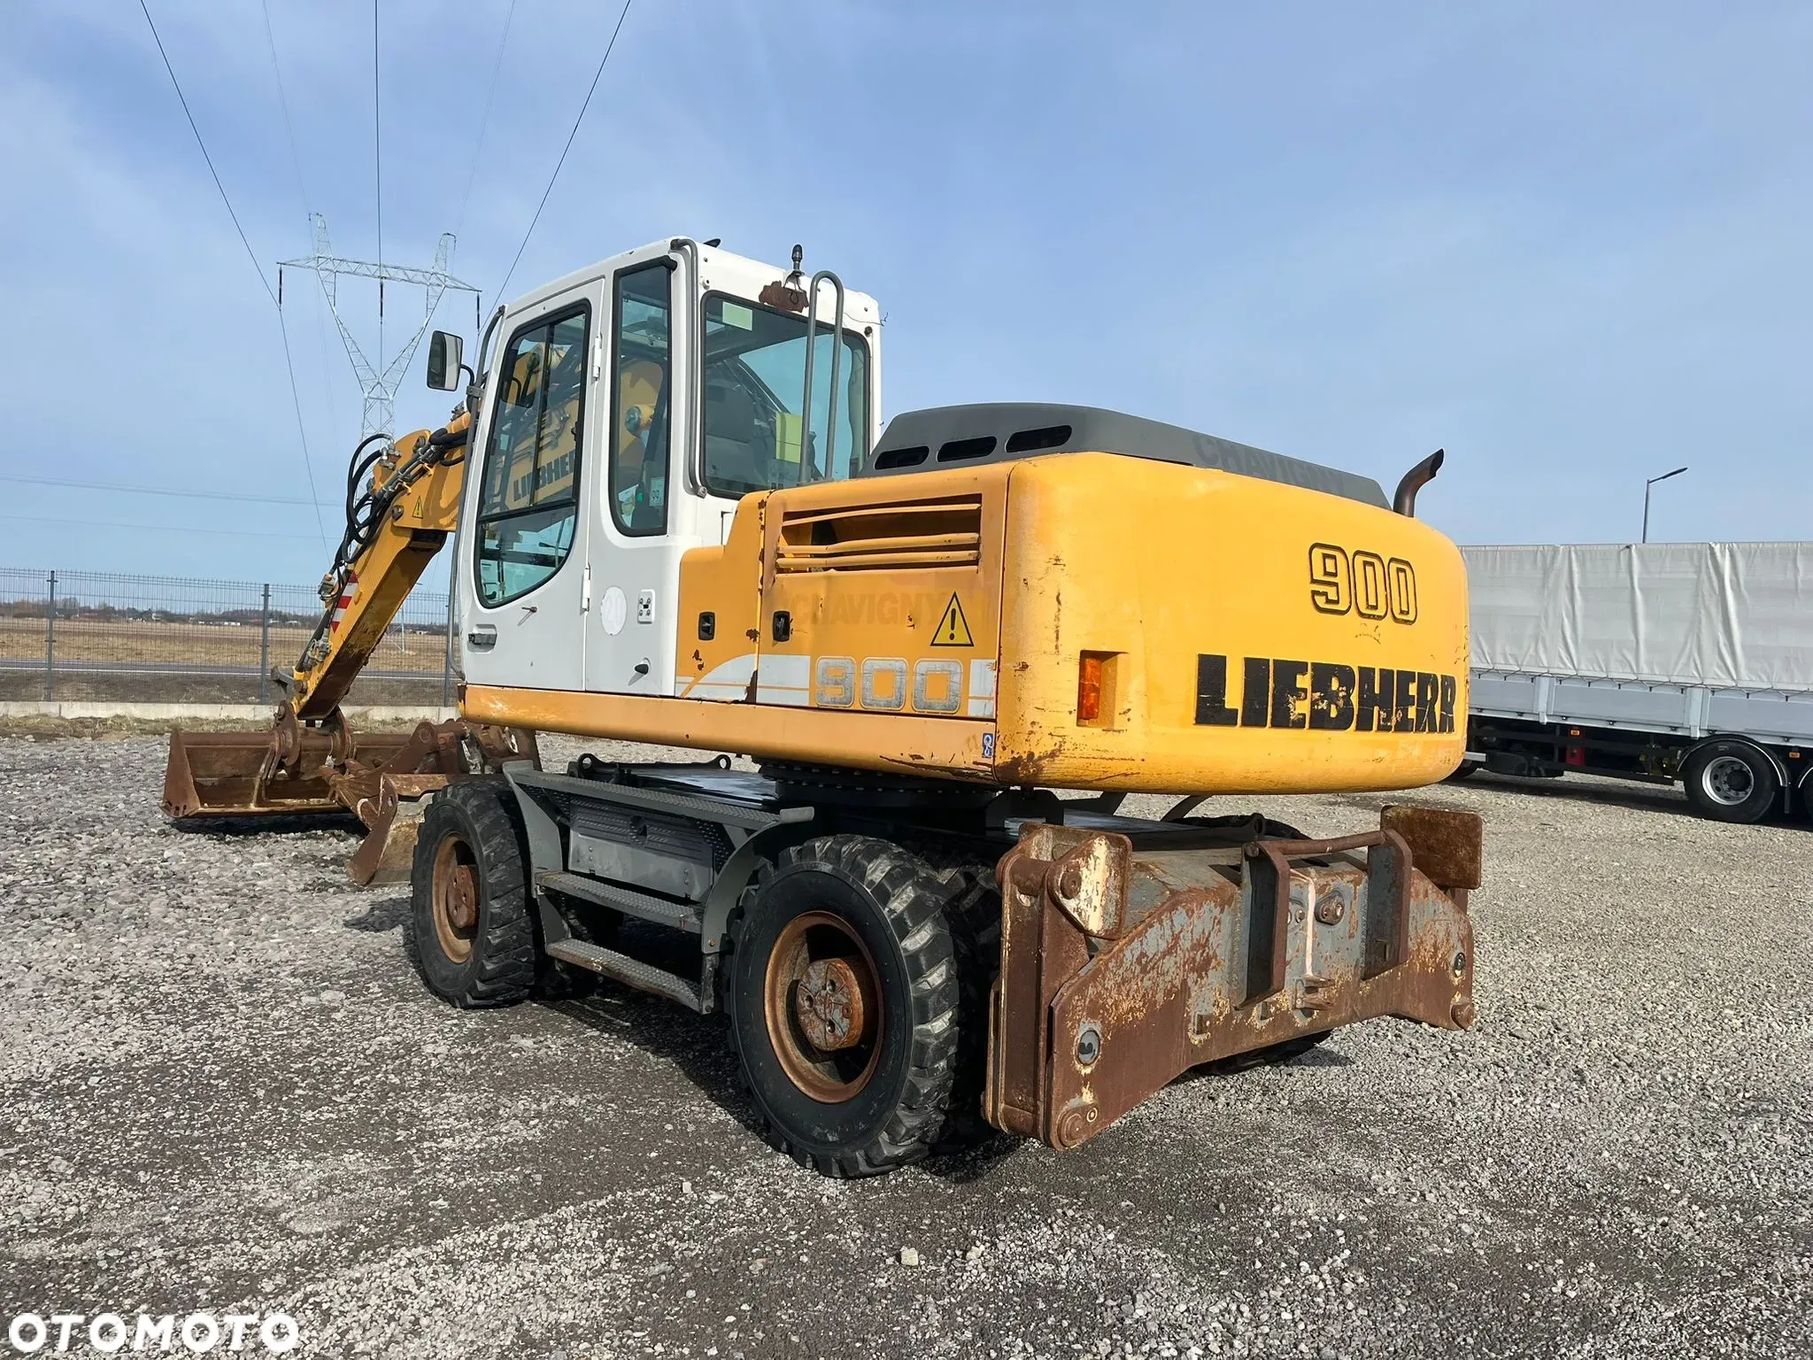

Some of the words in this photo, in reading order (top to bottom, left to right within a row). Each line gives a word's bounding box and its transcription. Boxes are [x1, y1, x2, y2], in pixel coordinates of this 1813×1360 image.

[1308, 542, 1417, 625] 900
[815, 655, 963, 714] 900
[1194, 653, 1456, 733] LIEBHERR
